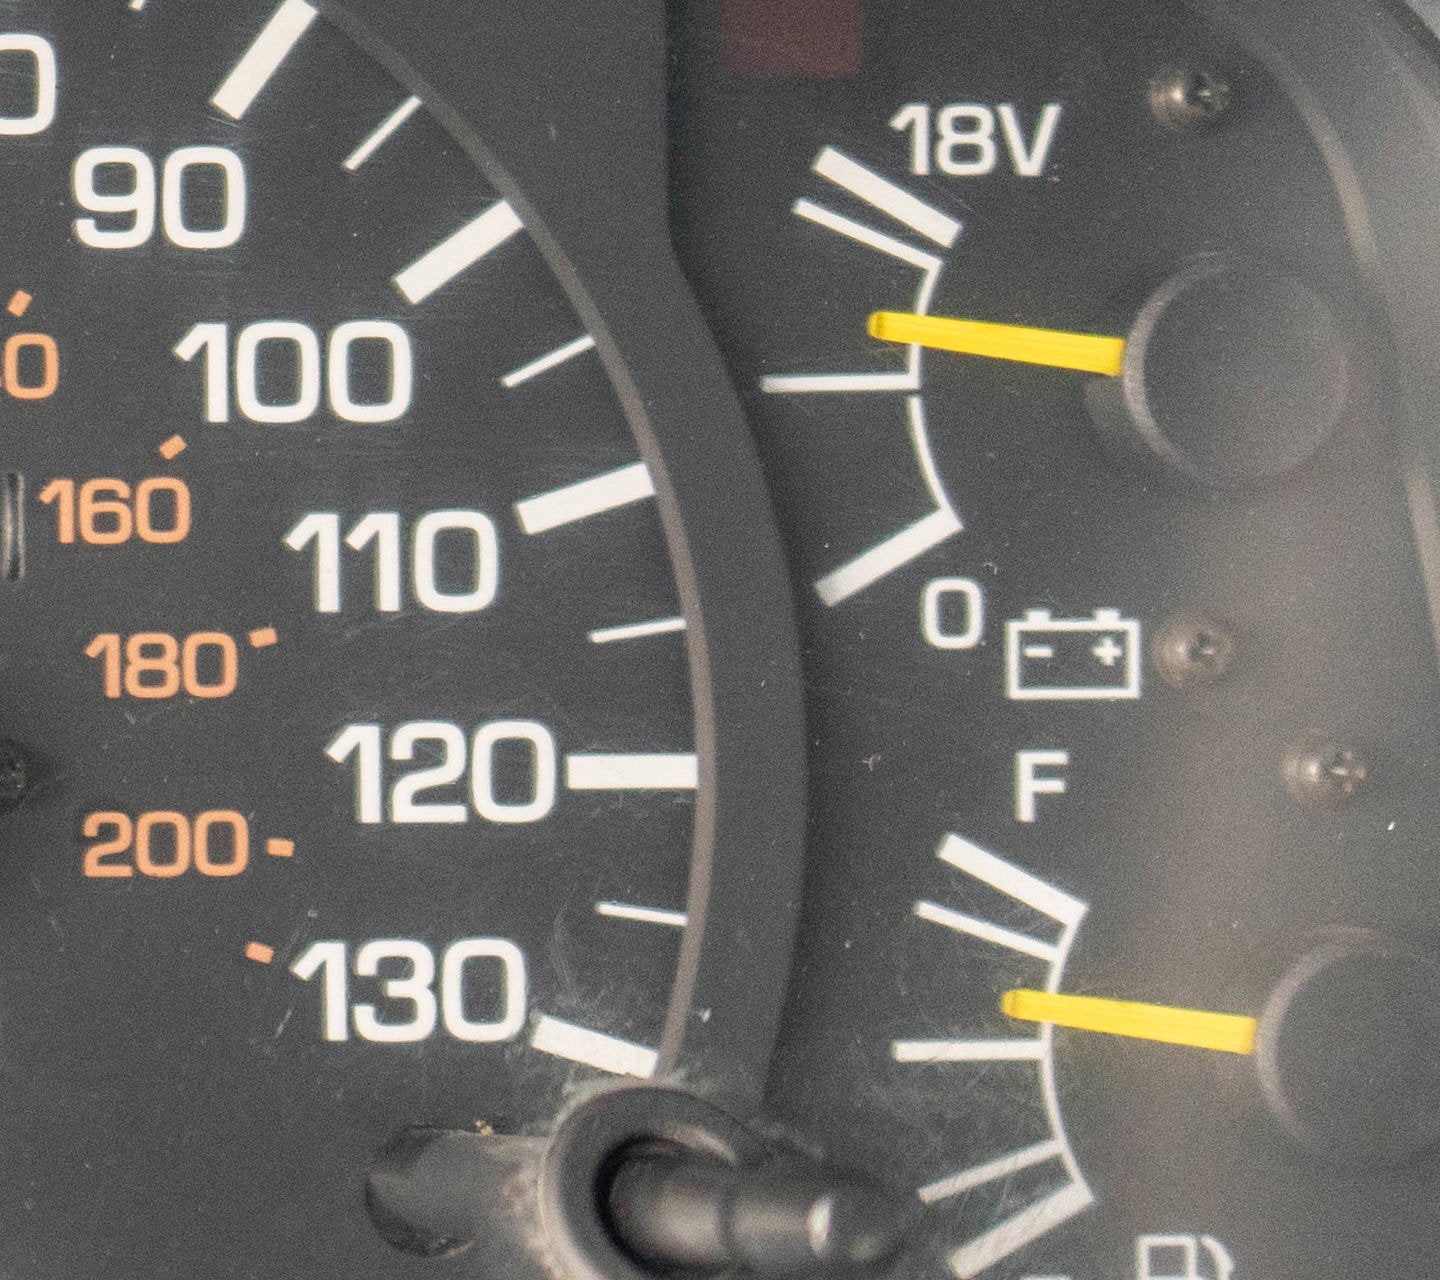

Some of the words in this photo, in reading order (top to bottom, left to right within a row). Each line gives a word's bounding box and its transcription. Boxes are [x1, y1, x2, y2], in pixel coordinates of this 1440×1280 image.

[889, 102, 1062, 177] 18V
[75, 146, 246, 248] 90
[174, 320, 413, 424] 100
[40, 478, 191, 545] 160
[284, 508, 499, 614] 110
[921, 576, 984, 650] 0
[85, 631, 238, 700] 180
[325, 720, 556, 824] 120
[1015, 750, 1069, 823] F
[82, 810, 250, 878] 200
[291, 938, 527, 1043] 130
